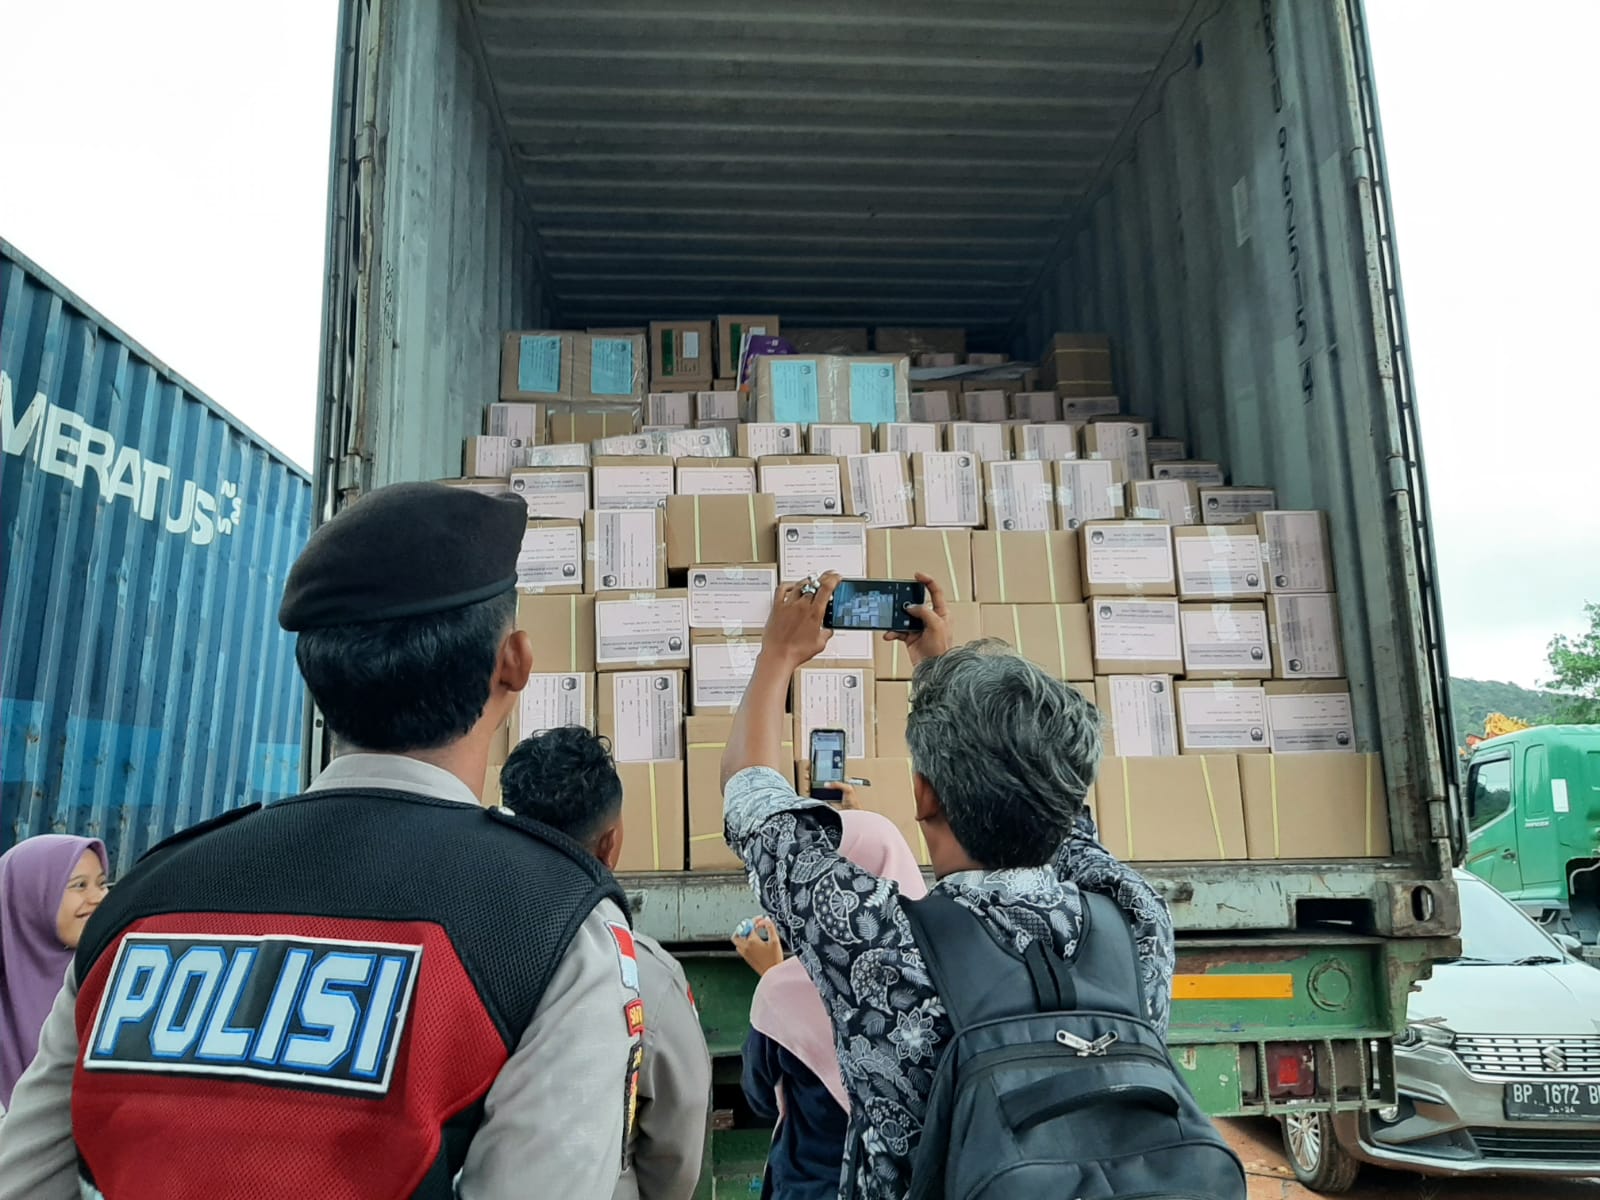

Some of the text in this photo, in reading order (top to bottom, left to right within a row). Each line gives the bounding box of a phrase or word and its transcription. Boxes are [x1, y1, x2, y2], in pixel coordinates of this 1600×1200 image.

[0, 369, 217, 545] MERATUS
[94, 943, 407, 1078] POLISI
[1543, 1085, 1580, 1104] 1672
[1588, 1085, 1600, 1105] B
